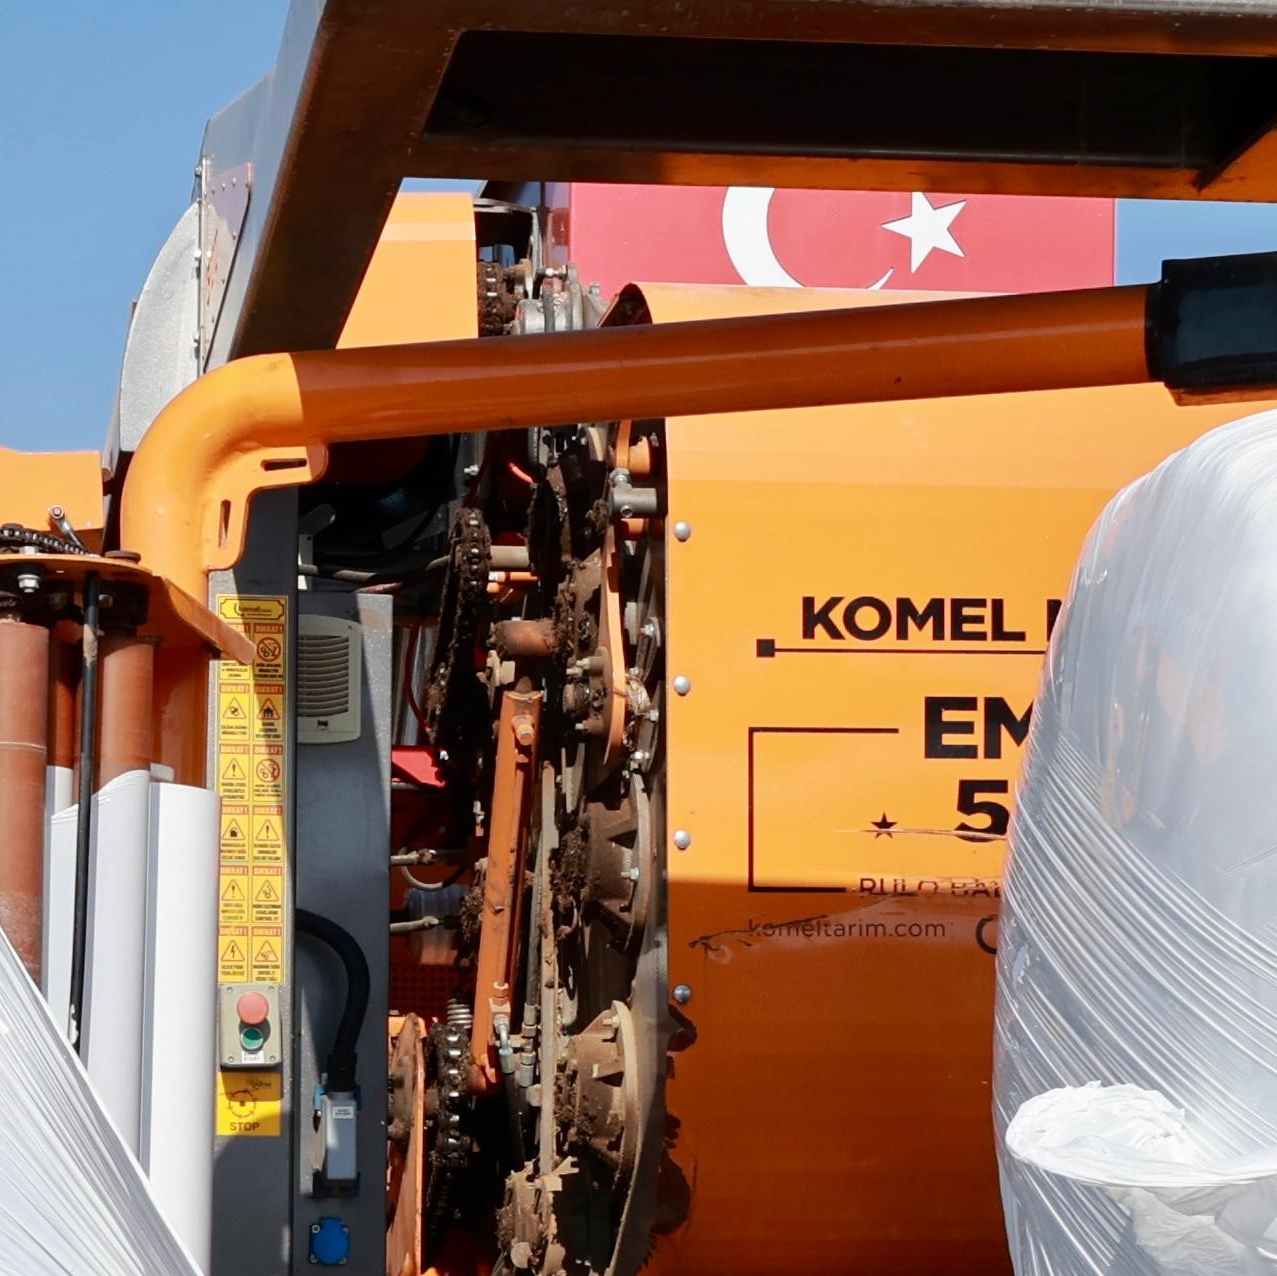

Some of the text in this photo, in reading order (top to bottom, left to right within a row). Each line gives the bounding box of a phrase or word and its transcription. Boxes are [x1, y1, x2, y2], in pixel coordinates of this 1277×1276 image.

[802, 596, 1026, 641] KOMEL
[748, 918, 946, 938] komeltarim.com
[229, 1121, 260, 1132] STOP
